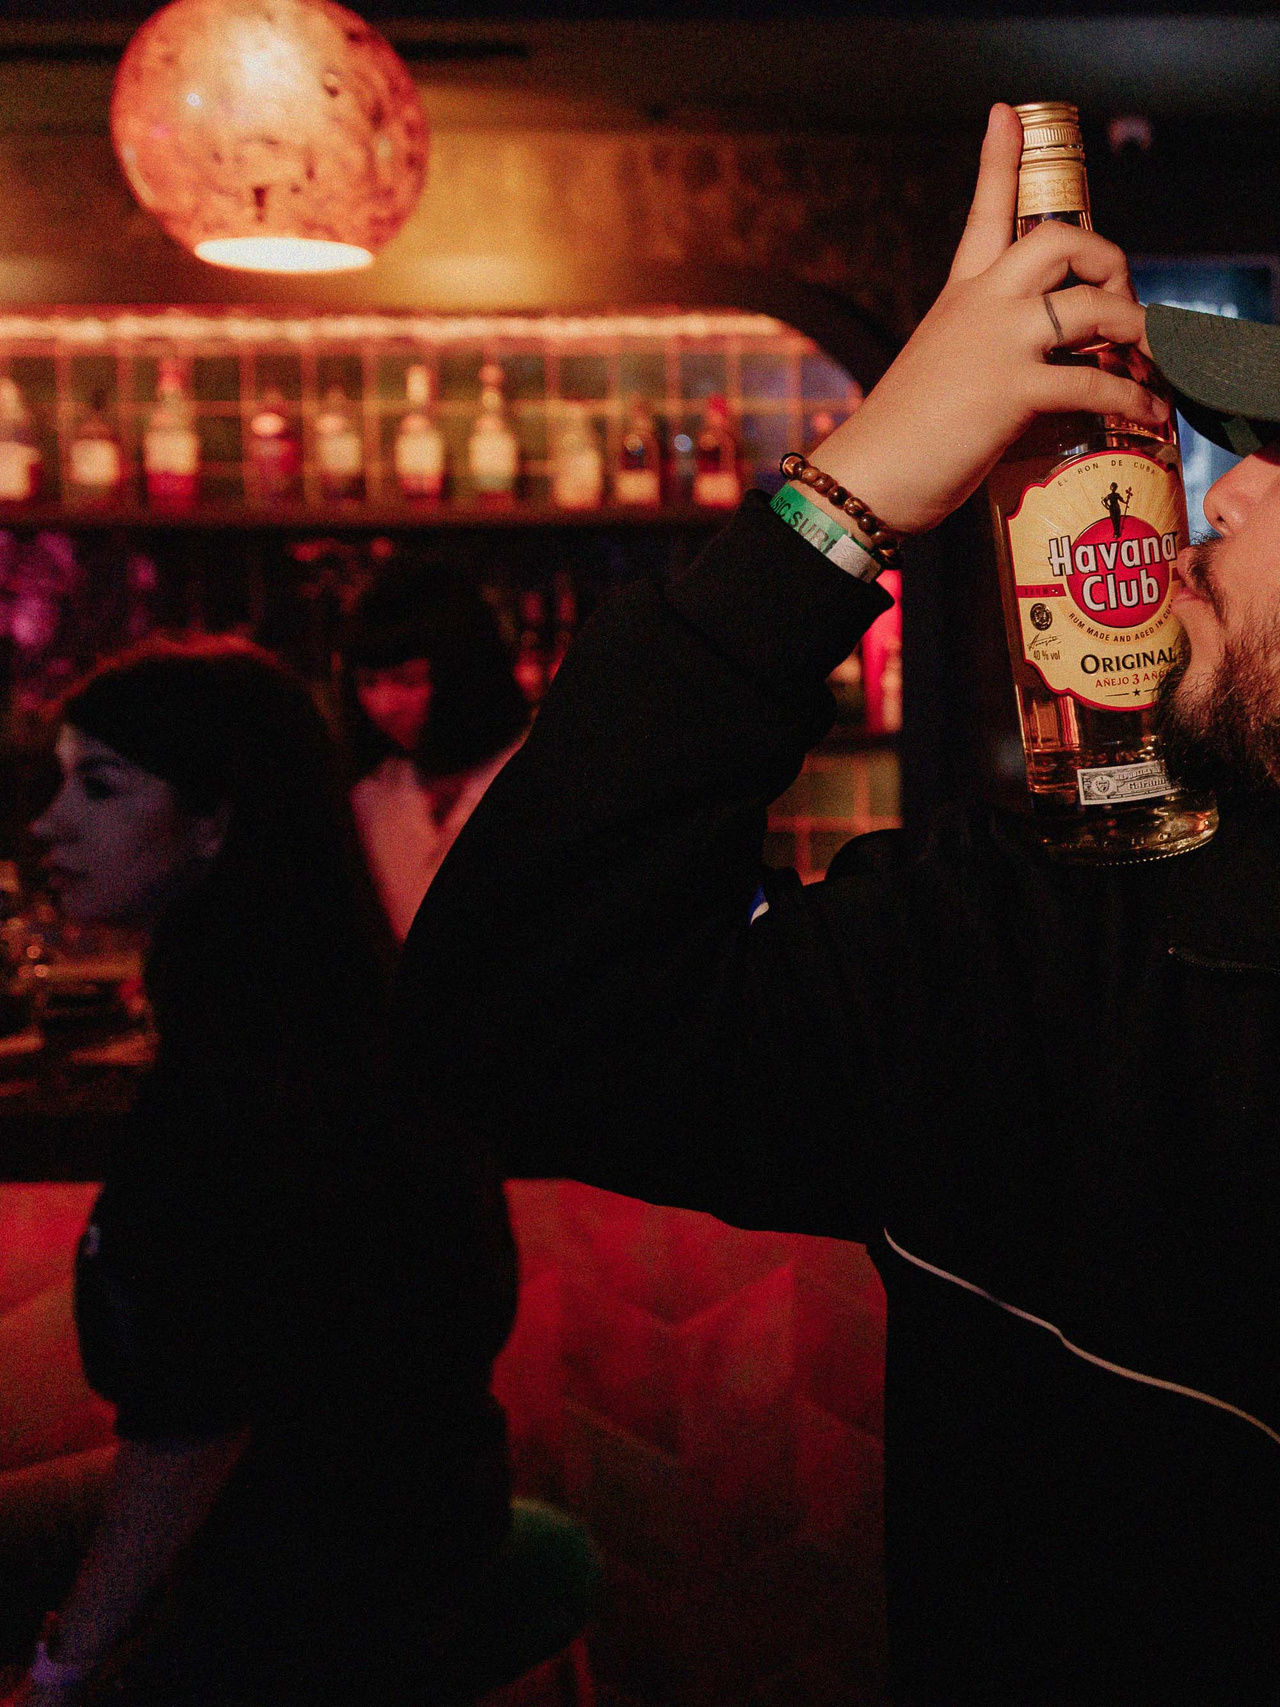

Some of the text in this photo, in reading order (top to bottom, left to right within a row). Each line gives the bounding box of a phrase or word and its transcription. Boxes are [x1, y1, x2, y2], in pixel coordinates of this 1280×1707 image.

[1077, 462, 1099, 475] RON
[1111, 459, 1123, 467] DE
[1133, 461, 1156, 475] CUBA
[1048, 531, 1178, 577] Havana
[1082, 568, 1161, 612] Club
[1068, 612, 1085, 629] RUM
[1086, 628, 1110, 641] MADE
[1113, 634, 1132, 643] AND
[1134, 628, 1155, 641] AGED
[1155, 619, 1164, 629] IN
[1033, 651, 1041, 661] 40
[1050, 649, 1061, 660] vol
[1080, 646, 1178, 675] ORIGINAL
[1095, 670, 1166, 688] AÑEJO 3 AÑO
